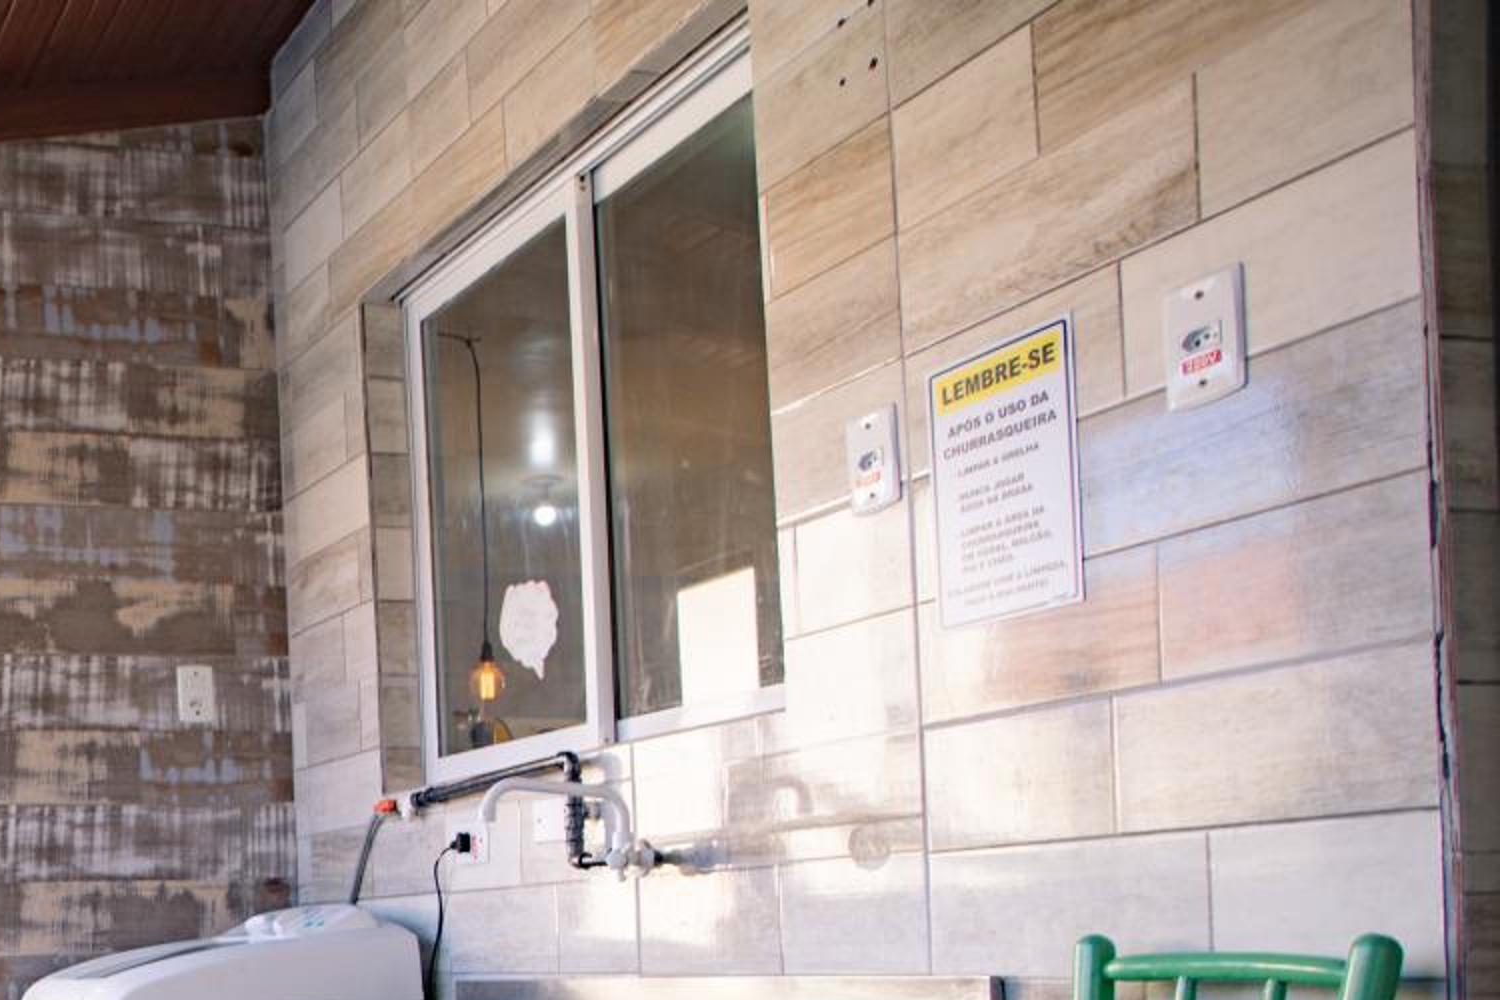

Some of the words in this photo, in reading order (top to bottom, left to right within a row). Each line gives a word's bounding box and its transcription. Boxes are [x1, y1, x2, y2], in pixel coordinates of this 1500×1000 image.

[942, 341, 1056, 406] LEMBRE-SE
[943, 409, 1057, 460] CHURRASQUEIRA
[948, 414, 981, 438] APÓS
[985, 411, 994, 424] O
[997, 399, 1027, 419] USO
[1030, 389, 1049, 407] DA
